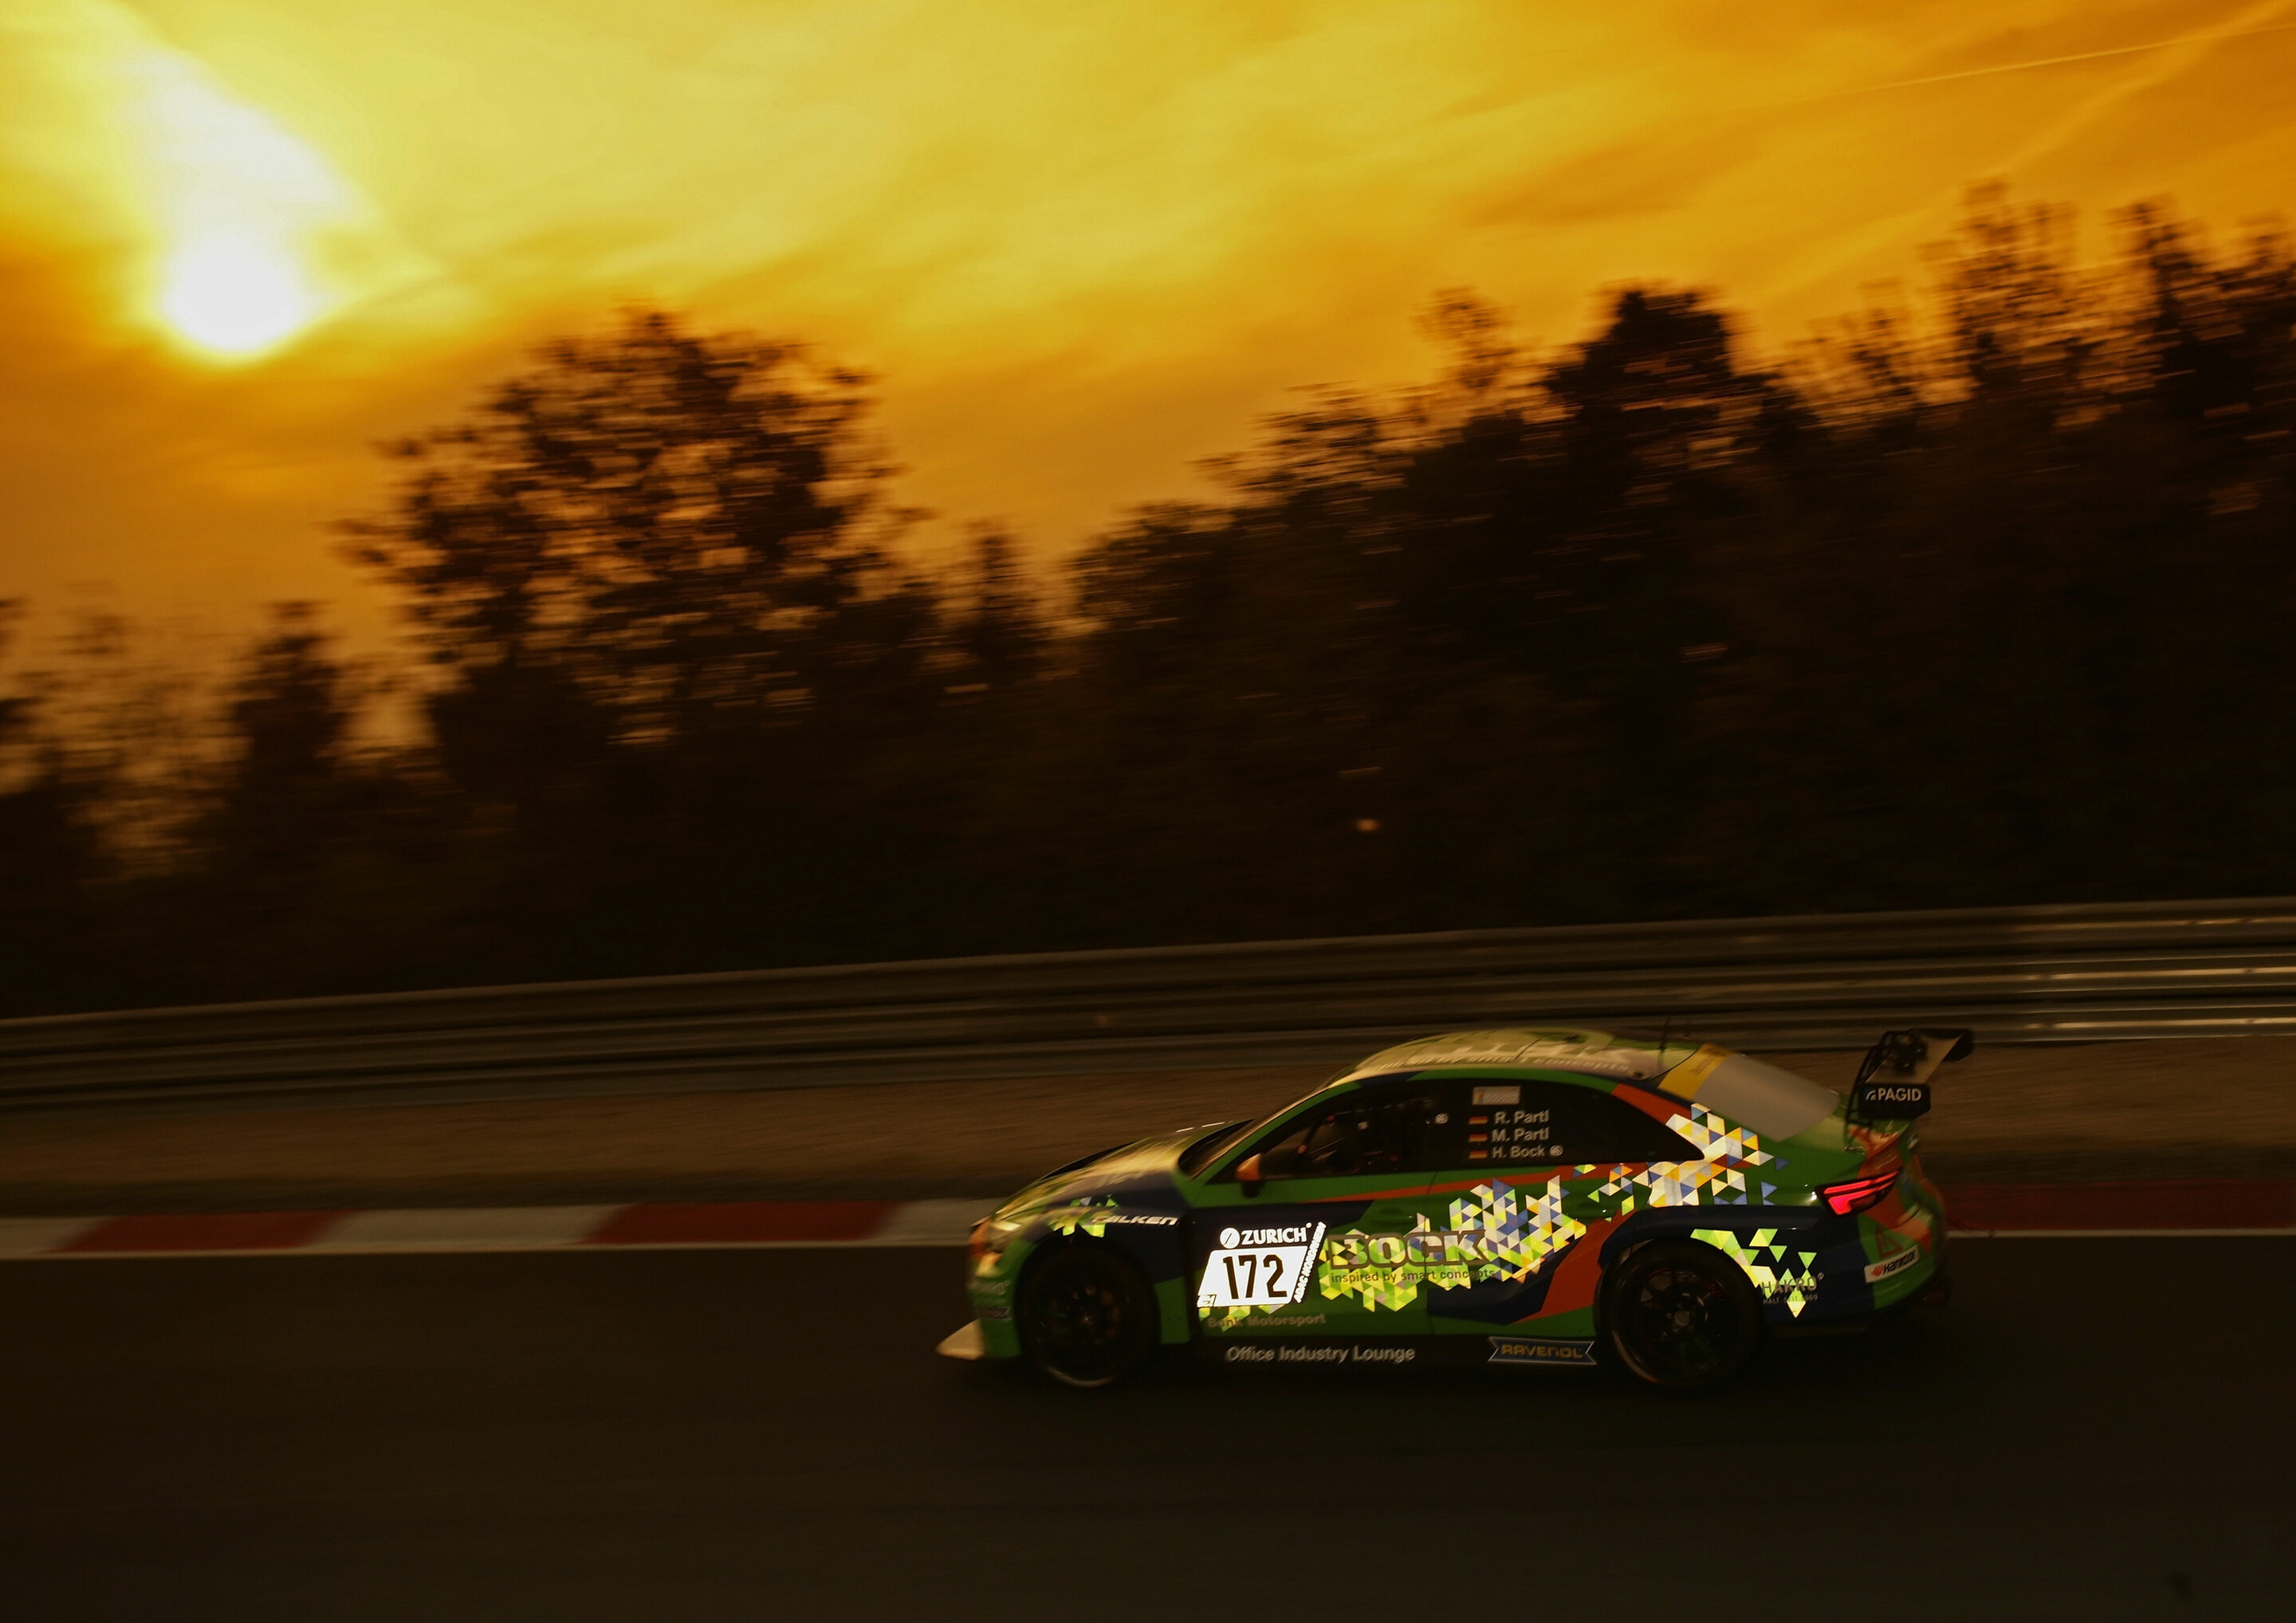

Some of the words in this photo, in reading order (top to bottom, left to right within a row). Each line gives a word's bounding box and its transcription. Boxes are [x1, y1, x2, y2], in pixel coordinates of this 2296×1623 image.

[1877, 1087, 1922, 1102] PAGID
[1495, 1110, 1512, 1124] R.
[1491, 1127, 1511, 1142] M.
[1492, 1146, 1508, 1159] H.
[1511, 1144, 1546, 1159] Bock
[1091, 1215, 1179, 1226] FALKEN
[1241, 1228, 1307, 1245] ZURICH
[1328, 1230, 1490, 1269] BOCK
[1223, 1254, 1288, 1300] 172
[1331, 1271, 1379, 1284] inspired
[1383, 1271, 1396, 1283] by
[1401, 1269, 1437, 1281] smart
[1294, 1275, 1308, 1303] ADAC
[1247, 1313, 1327, 1328] Motorsport
[1225, 1346, 1275, 1363] Office
[1277, 1346, 1350, 1365] Industry
[1352, 1345, 1417, 1365] Lounge
[1501, 1344, 1583, 1359] RAVENOL
